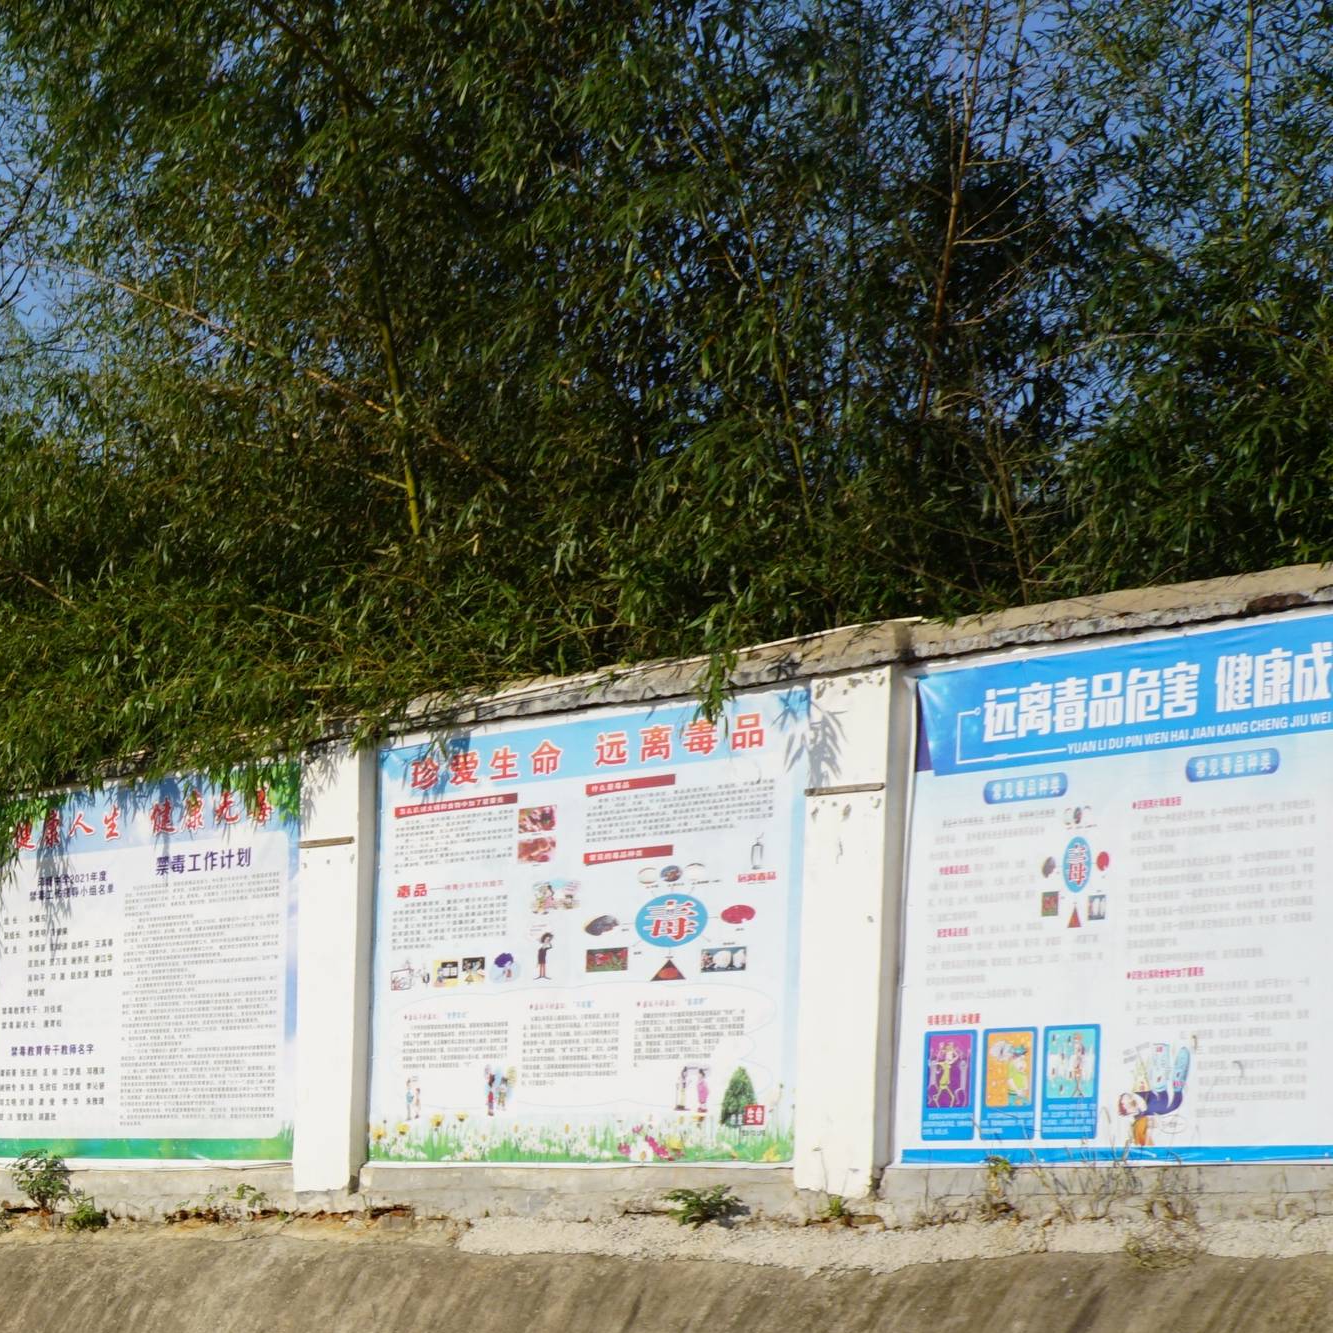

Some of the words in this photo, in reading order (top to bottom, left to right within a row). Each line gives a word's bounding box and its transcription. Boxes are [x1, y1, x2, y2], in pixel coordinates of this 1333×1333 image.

[983, 662, 1200, 743] 远离毒品危害
[1215, 642, 1332, 713] 健康成
[1067, 741, 1096, 755] YUAN
[1098, 739, 1108, 751] LI
[1109, 737, 1124, 749] DU
[1125, 735, 1143, 747] PIN
[1170, 729, 1189, 743] HAI
[1191, 726, 1215, 740] JIAN
[1217, 722, 1249, 737] KANG
[1250, 717, 1289, 733] CHENG
[1290, 714, 1309, 728] JIU
[411, 740, 562, 790] 珍爱生命
[595, 713, 765, 767] 远离毒品
[1195, 752, 1271, 778] 常见毒品种类
[591, 781, 630, 793] 什么是毒品
[991, 775, 1062, 800] 常见毒品种类
[14, 806, 121, 850] 健康人生
[155, 847, 251, 876] 禁毒工作计划
[29, 883, 114, 902] 禁毒工作领导小组名单
[645, 900, 695, 941] 毒
[11, 1044, 94, 1056] 禁毒教育骨干教师名字
